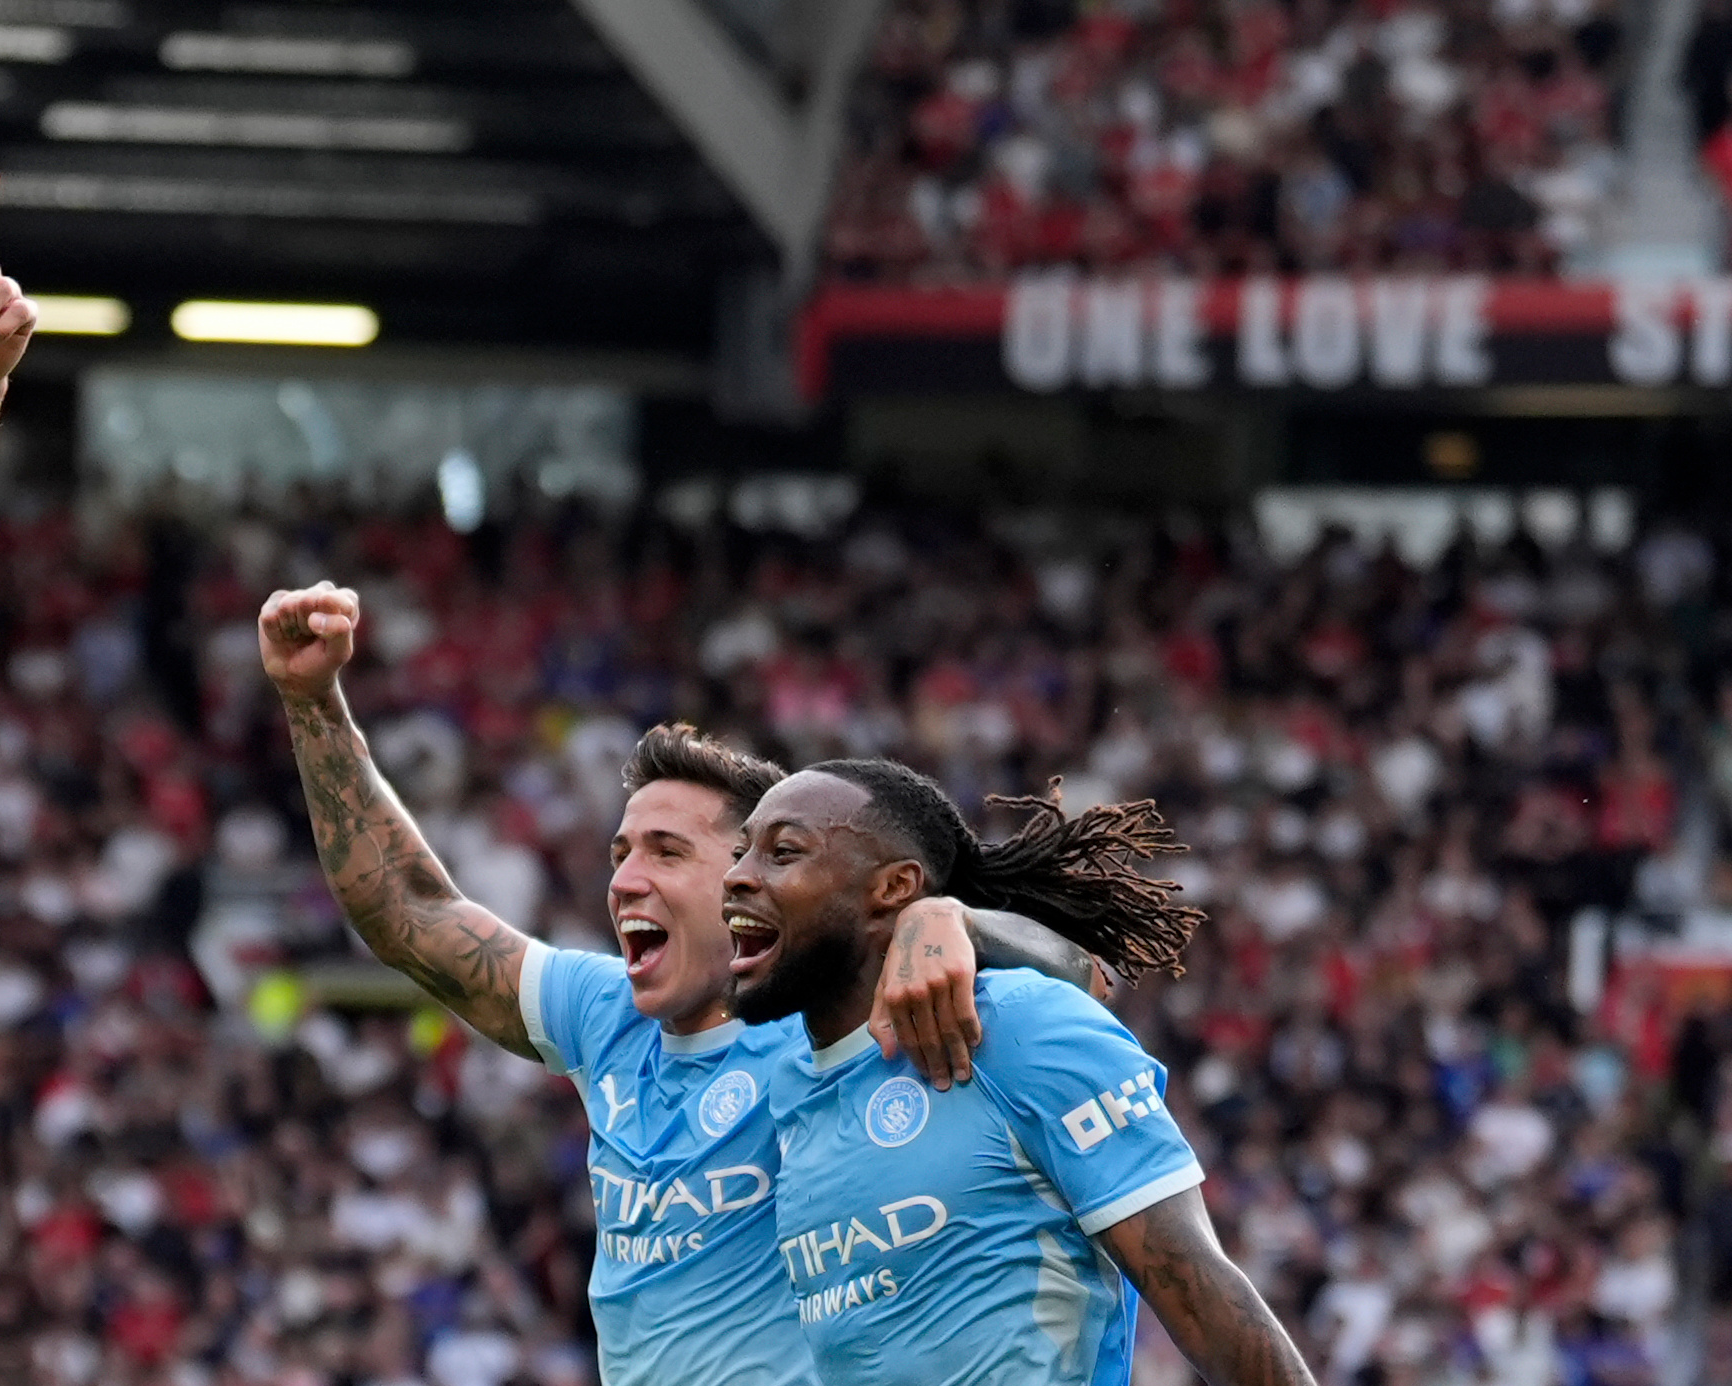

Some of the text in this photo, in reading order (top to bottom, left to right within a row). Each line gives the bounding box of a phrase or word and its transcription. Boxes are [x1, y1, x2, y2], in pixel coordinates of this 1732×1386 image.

[1004, 268, 1212, 388] ONE
[1240, 272, 1492, 387] LOVE
[924, 945, 942, 957] 24
[799, 1268, 898, 1329] AIRWAYS
